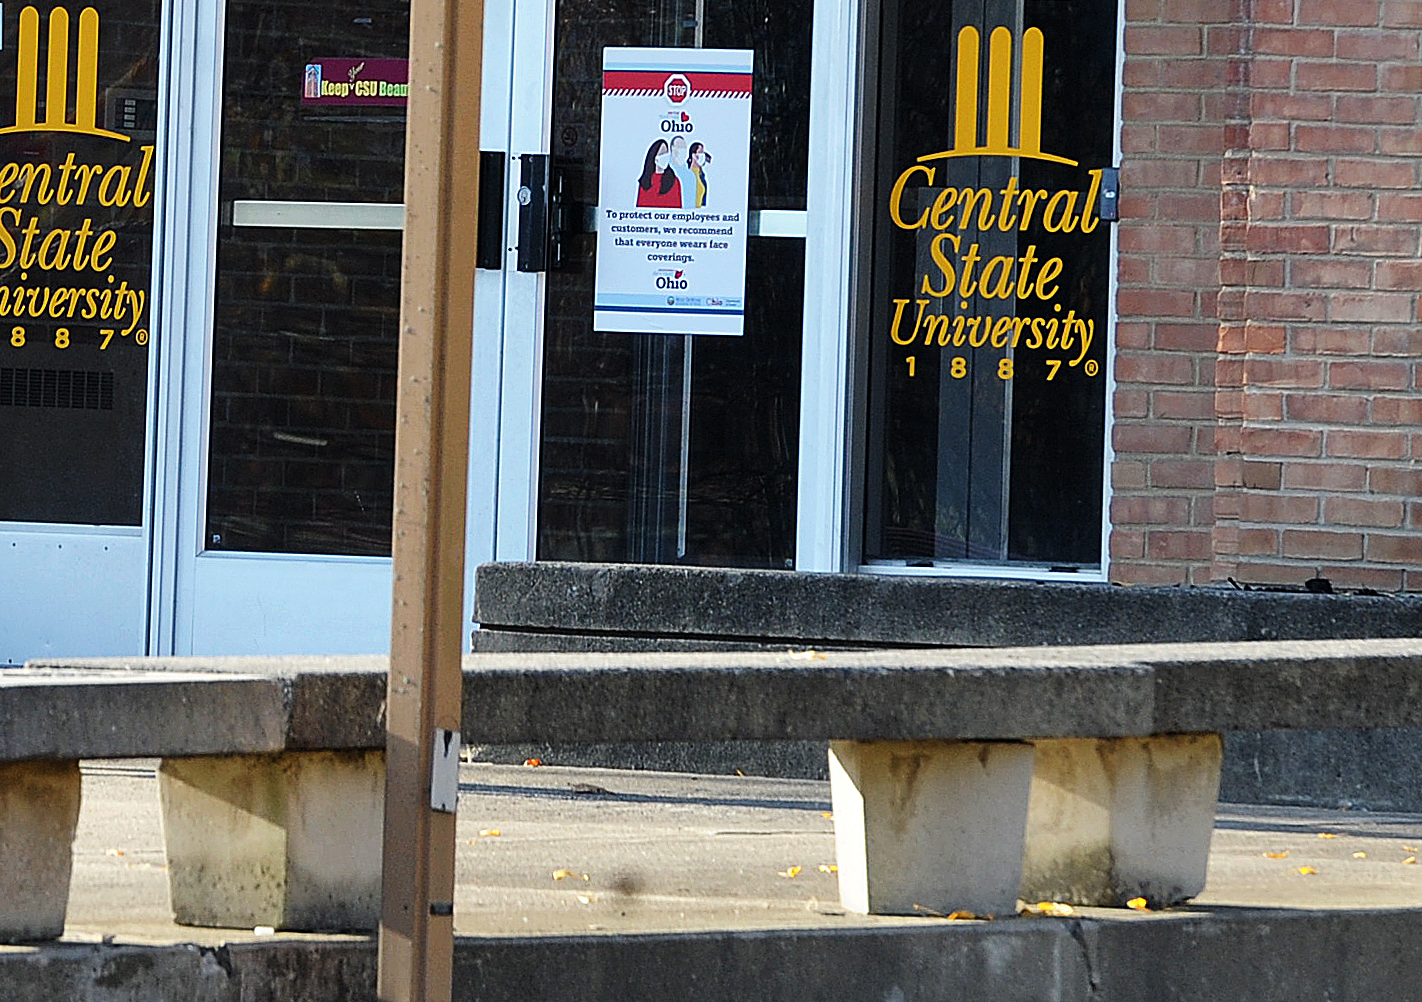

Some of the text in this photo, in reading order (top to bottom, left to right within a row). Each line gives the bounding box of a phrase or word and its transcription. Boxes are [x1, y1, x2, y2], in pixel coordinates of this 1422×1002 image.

[321, 80, 349, 97] Keep
[355, 80, 378, 97] CSU
[668, 85, 687, 96] STOP
[660, 119, 694, 133] Ohio
[889, 165, 1103, 234] Central
[606, 209, 739, 223] To protect our employees and
[611, 224, 733, 236] customers, we recommend
[614, 237, 729, 249] that everyone wears face
[647, 252, 695, 264] coverings.
[921, 232, 1064, 301] State
[656, 276, 688, 290] Ohio
[890, 298, 1095, 367] University
